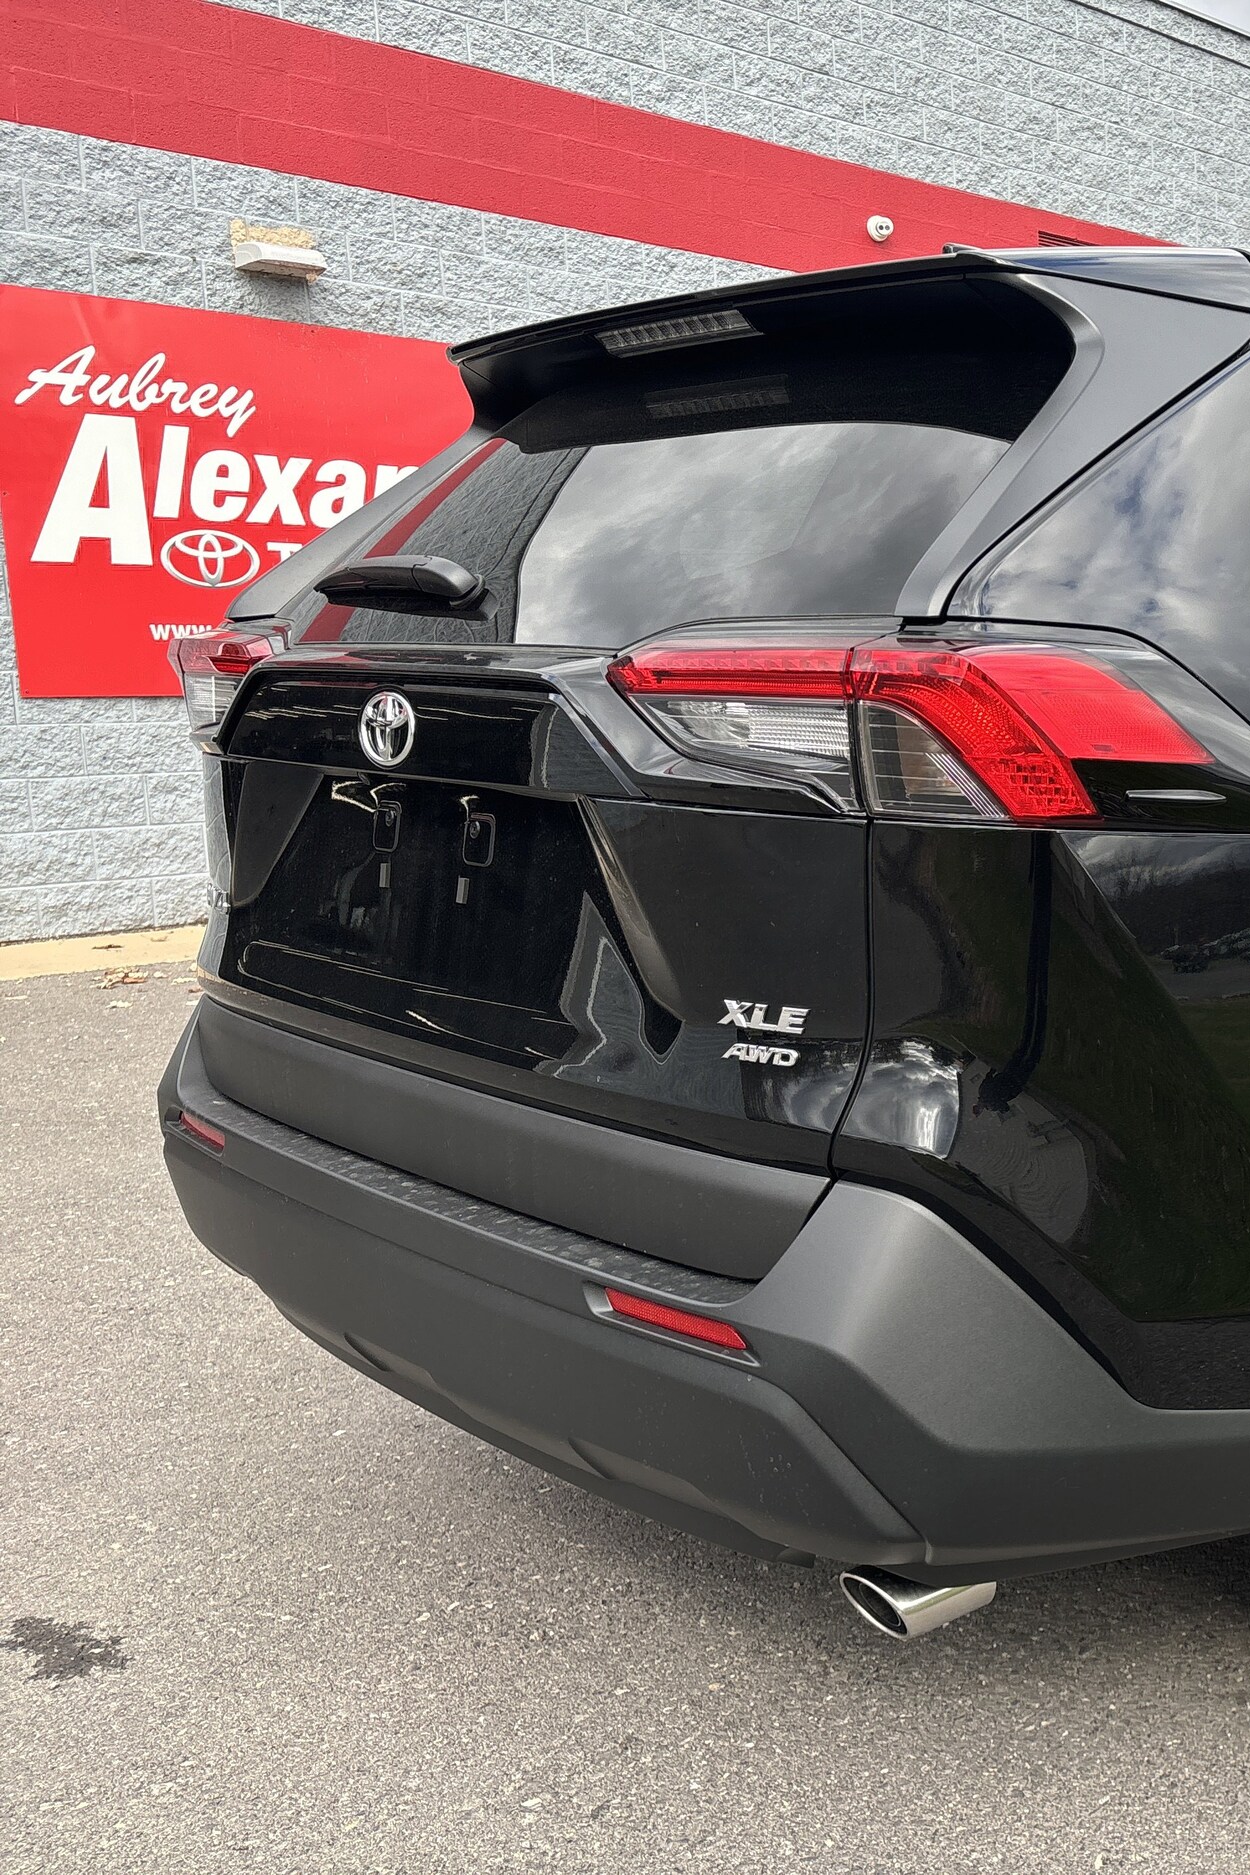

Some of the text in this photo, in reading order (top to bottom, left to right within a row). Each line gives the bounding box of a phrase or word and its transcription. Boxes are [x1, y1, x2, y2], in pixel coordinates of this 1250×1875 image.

[13, 344, 257, 439] Aubrey
[717, 999, 811, 1035] XLE
[721, 1042, 801, 1068] AWD
